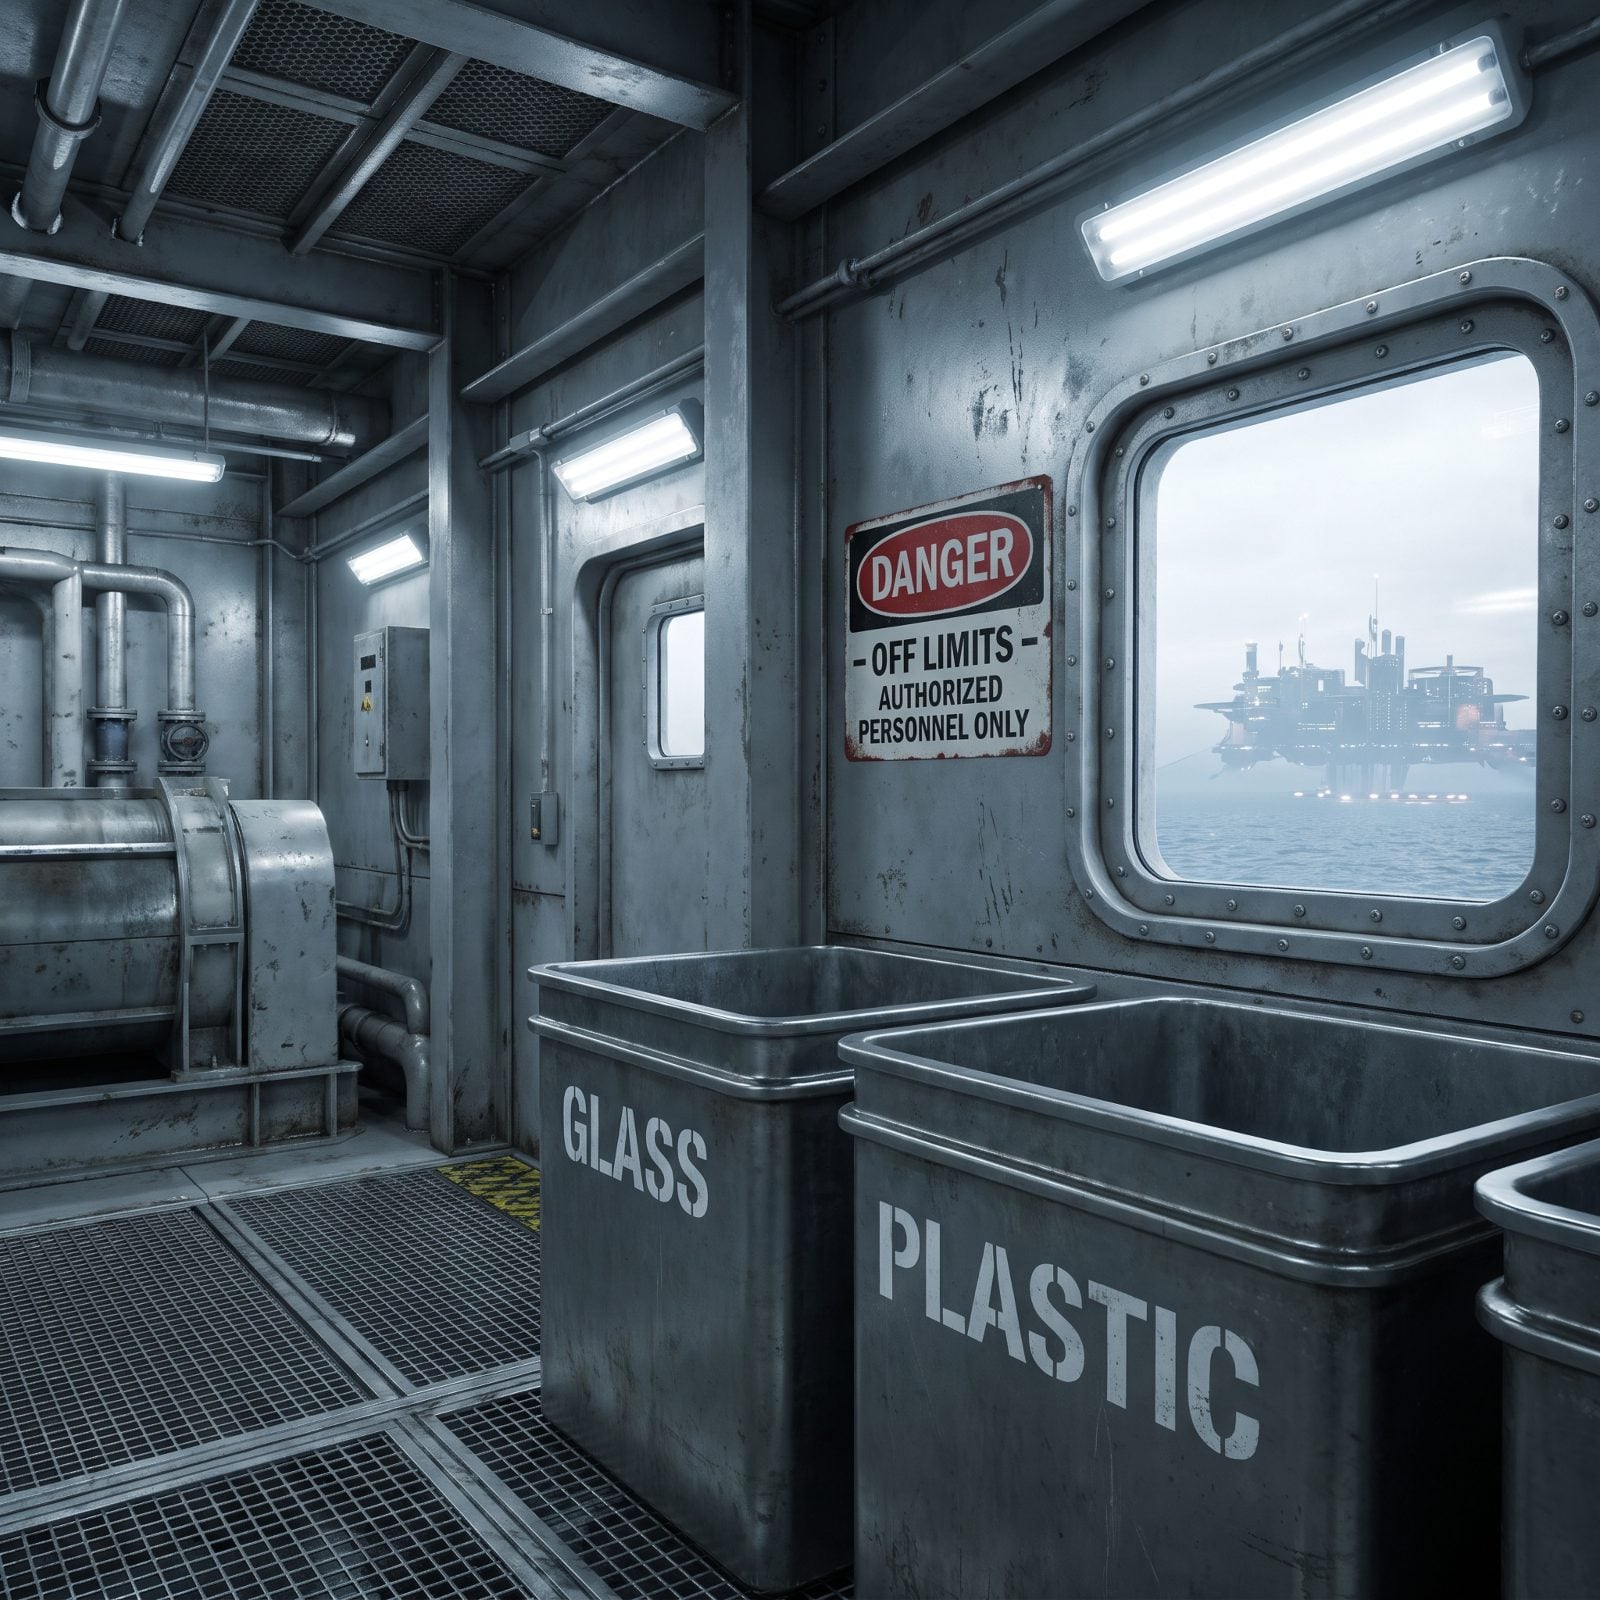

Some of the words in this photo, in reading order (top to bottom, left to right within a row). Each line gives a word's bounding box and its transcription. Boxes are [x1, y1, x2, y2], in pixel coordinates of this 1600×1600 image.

[872, 527, 1015, 602] DANGER
[871, 637, 917, 677] OFF
[923, 624, 1014, 671] LIMITS
[878, 674, 1003, 711] AUTHORIZED
[858, 713, 969, 744] PERSONNEL
[974, 708, 1030, 740] ONLY
[563, 1085, 709, 1218] GLASS
[879, 1200, 1260, 1460] PLASTIC
